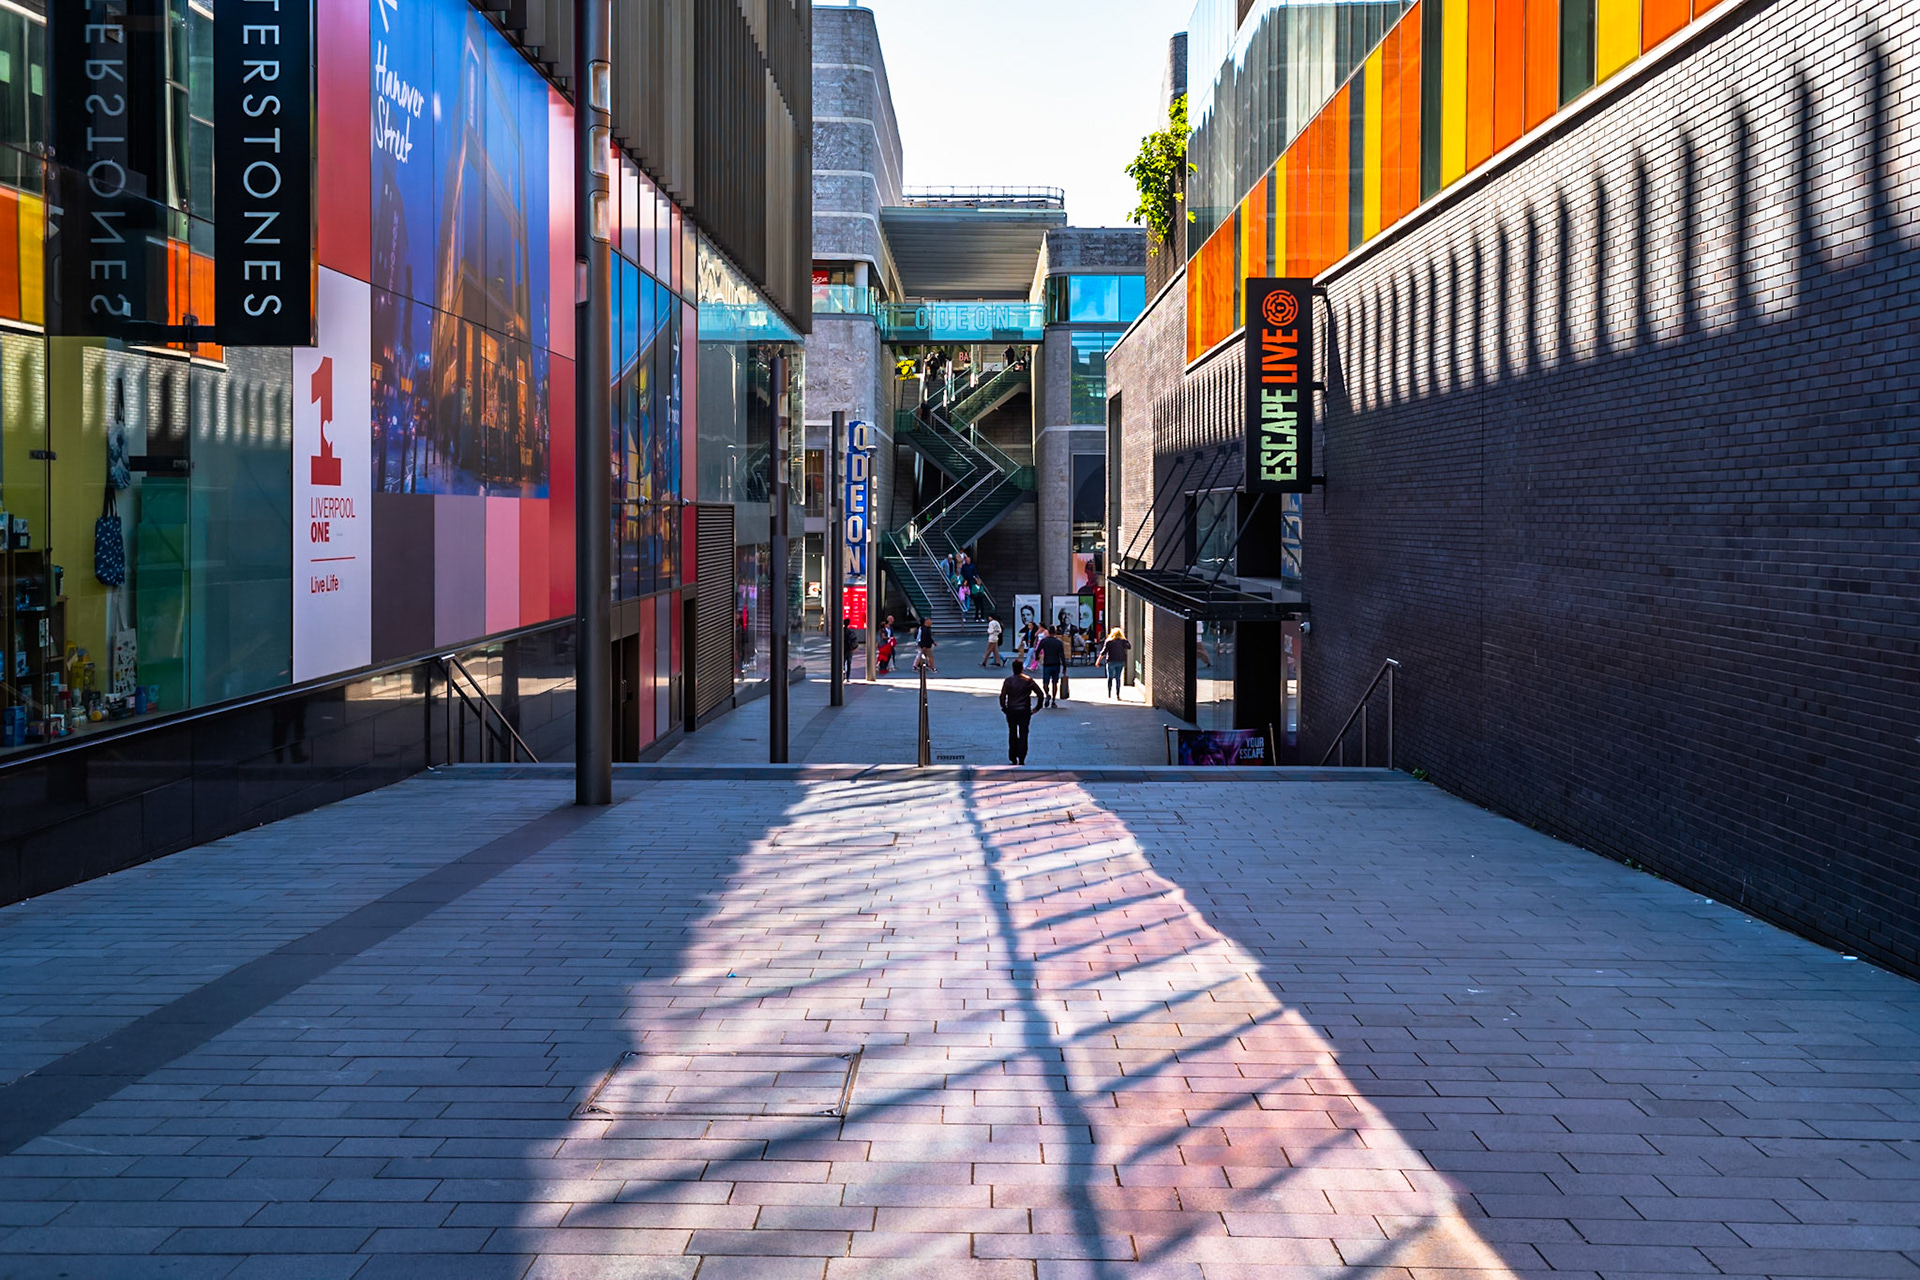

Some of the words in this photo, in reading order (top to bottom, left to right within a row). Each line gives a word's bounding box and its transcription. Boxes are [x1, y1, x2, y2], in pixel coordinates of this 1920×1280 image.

[375, 40, 424, 119] Hanover
[375, 95, 413, 164] Street
[914, 306, 1010, 330] ODEON
[1261, 328, 1298, 383] LIVE
[1261, 388, 1298, 481] ESCAPE
[310, 497, 356, 518] LIVERPOOL
[846, 423, 868, 574] ODEON
[310, 521, 330, 543] ONE
[310, 576, 325, 593] Live
[326, 574, 339, 591] Life
[1240, 748, 1264, 758] ESCAPE
[1246, 737, 1264, 747] YOUR
